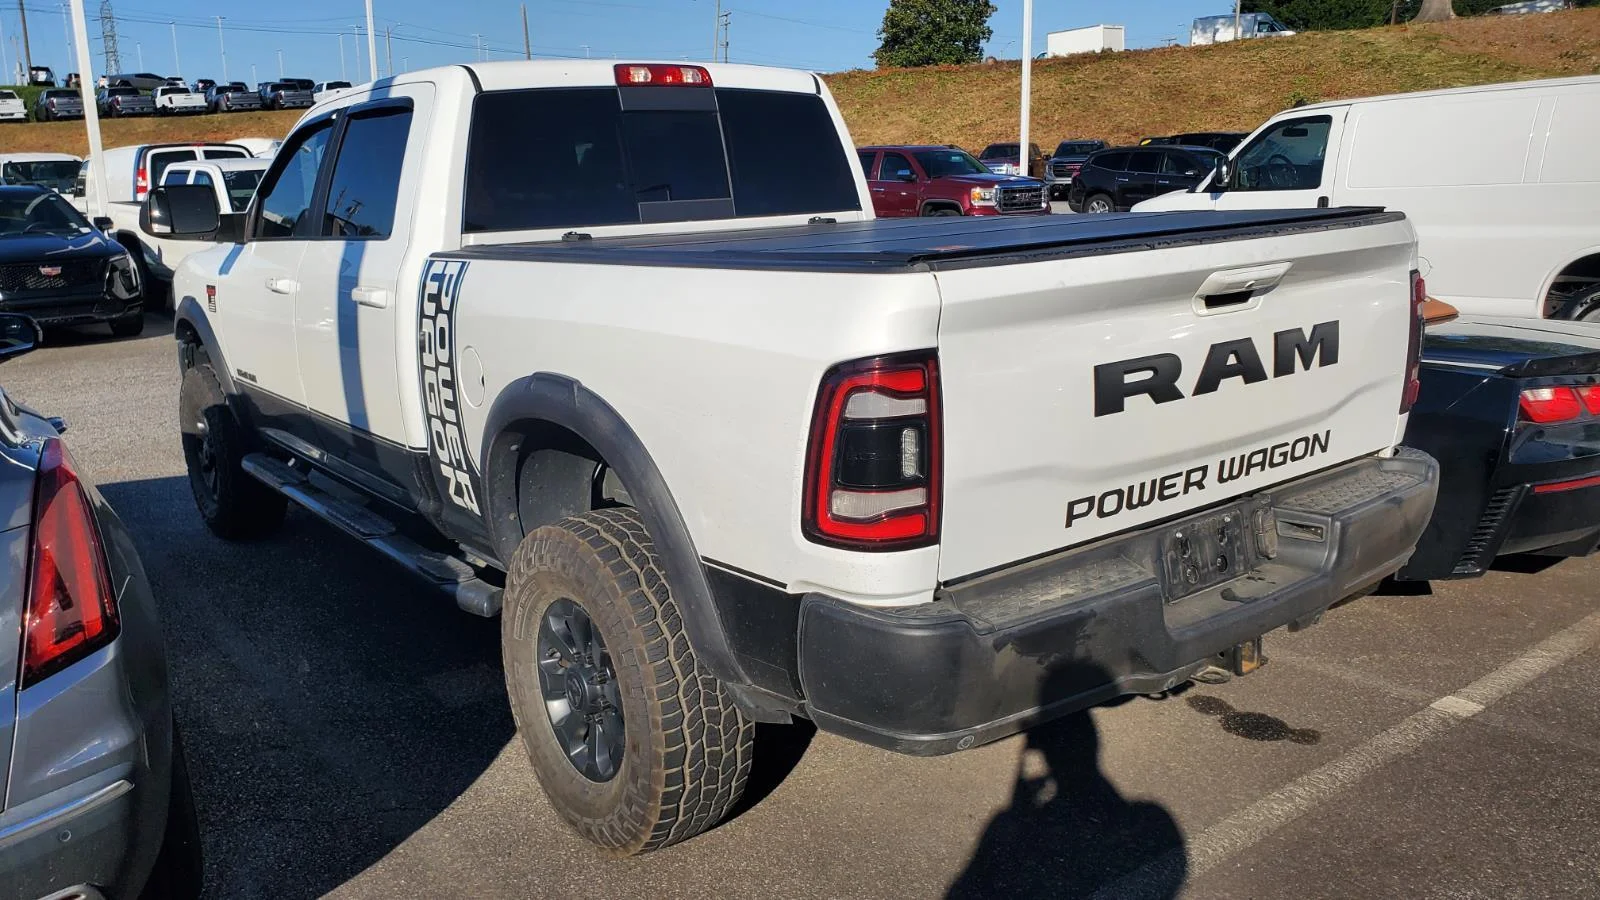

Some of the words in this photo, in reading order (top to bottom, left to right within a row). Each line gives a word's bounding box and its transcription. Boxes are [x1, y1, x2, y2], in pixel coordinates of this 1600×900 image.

[436, 262, 481, 516] POWER
[1094, 320, 1339, 417] RAM
[1065, 465, 1208, 528] POWER
[1217, 430, 1331, 484] WAGON
